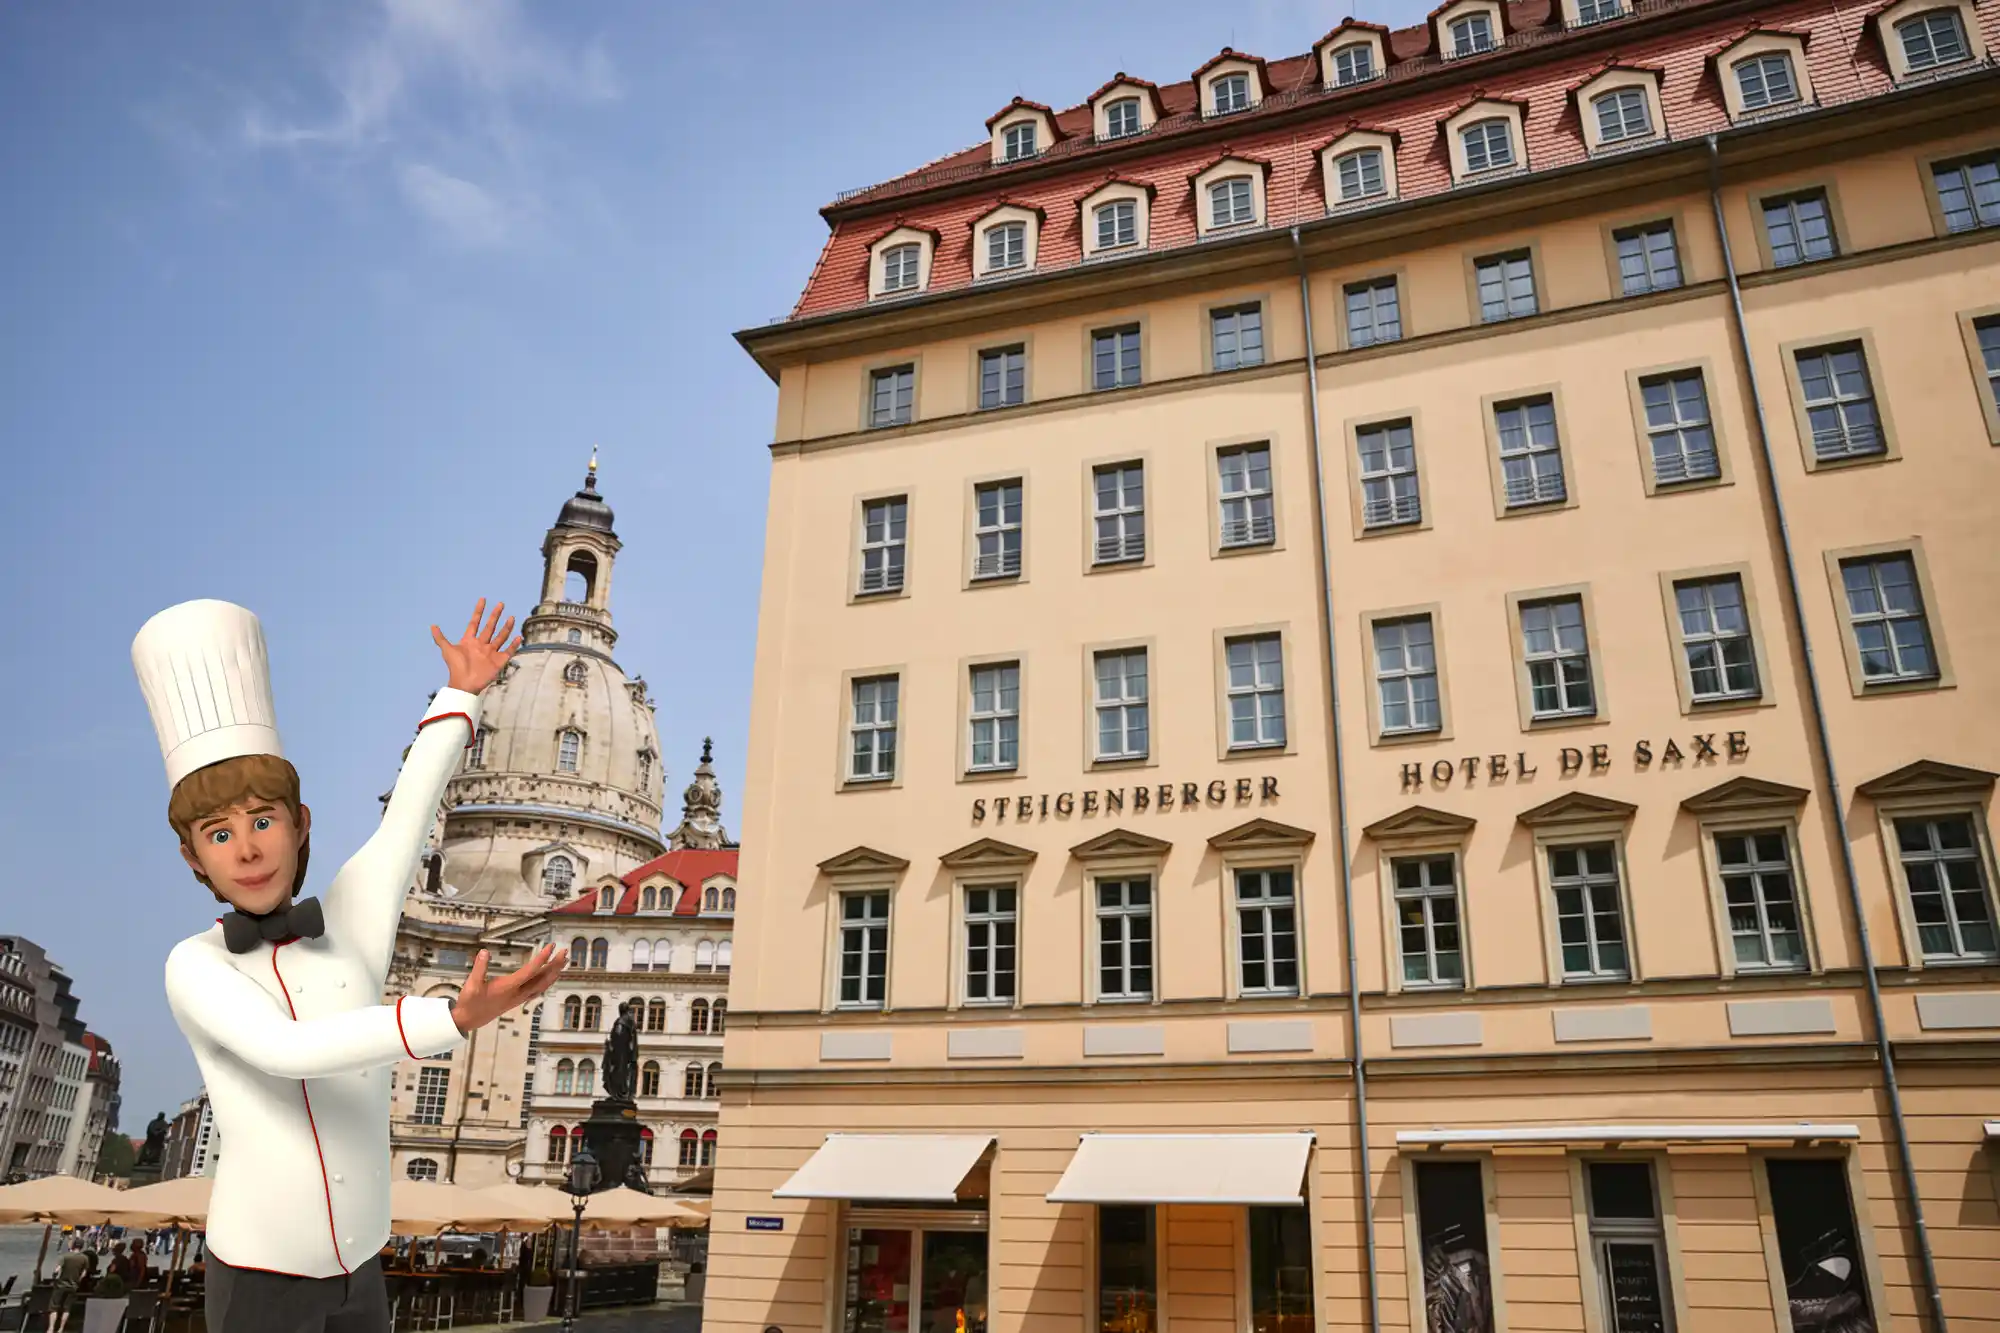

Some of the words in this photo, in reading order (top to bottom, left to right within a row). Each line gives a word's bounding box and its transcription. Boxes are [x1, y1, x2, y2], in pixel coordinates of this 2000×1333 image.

[1401, 751, 1537, 785] HOTEL
[1560, 744, 1610, 772] DE
[1635, 731, 1750, 765] SAXE
[972, 776, 1281, 821] STEIGENBERGER
